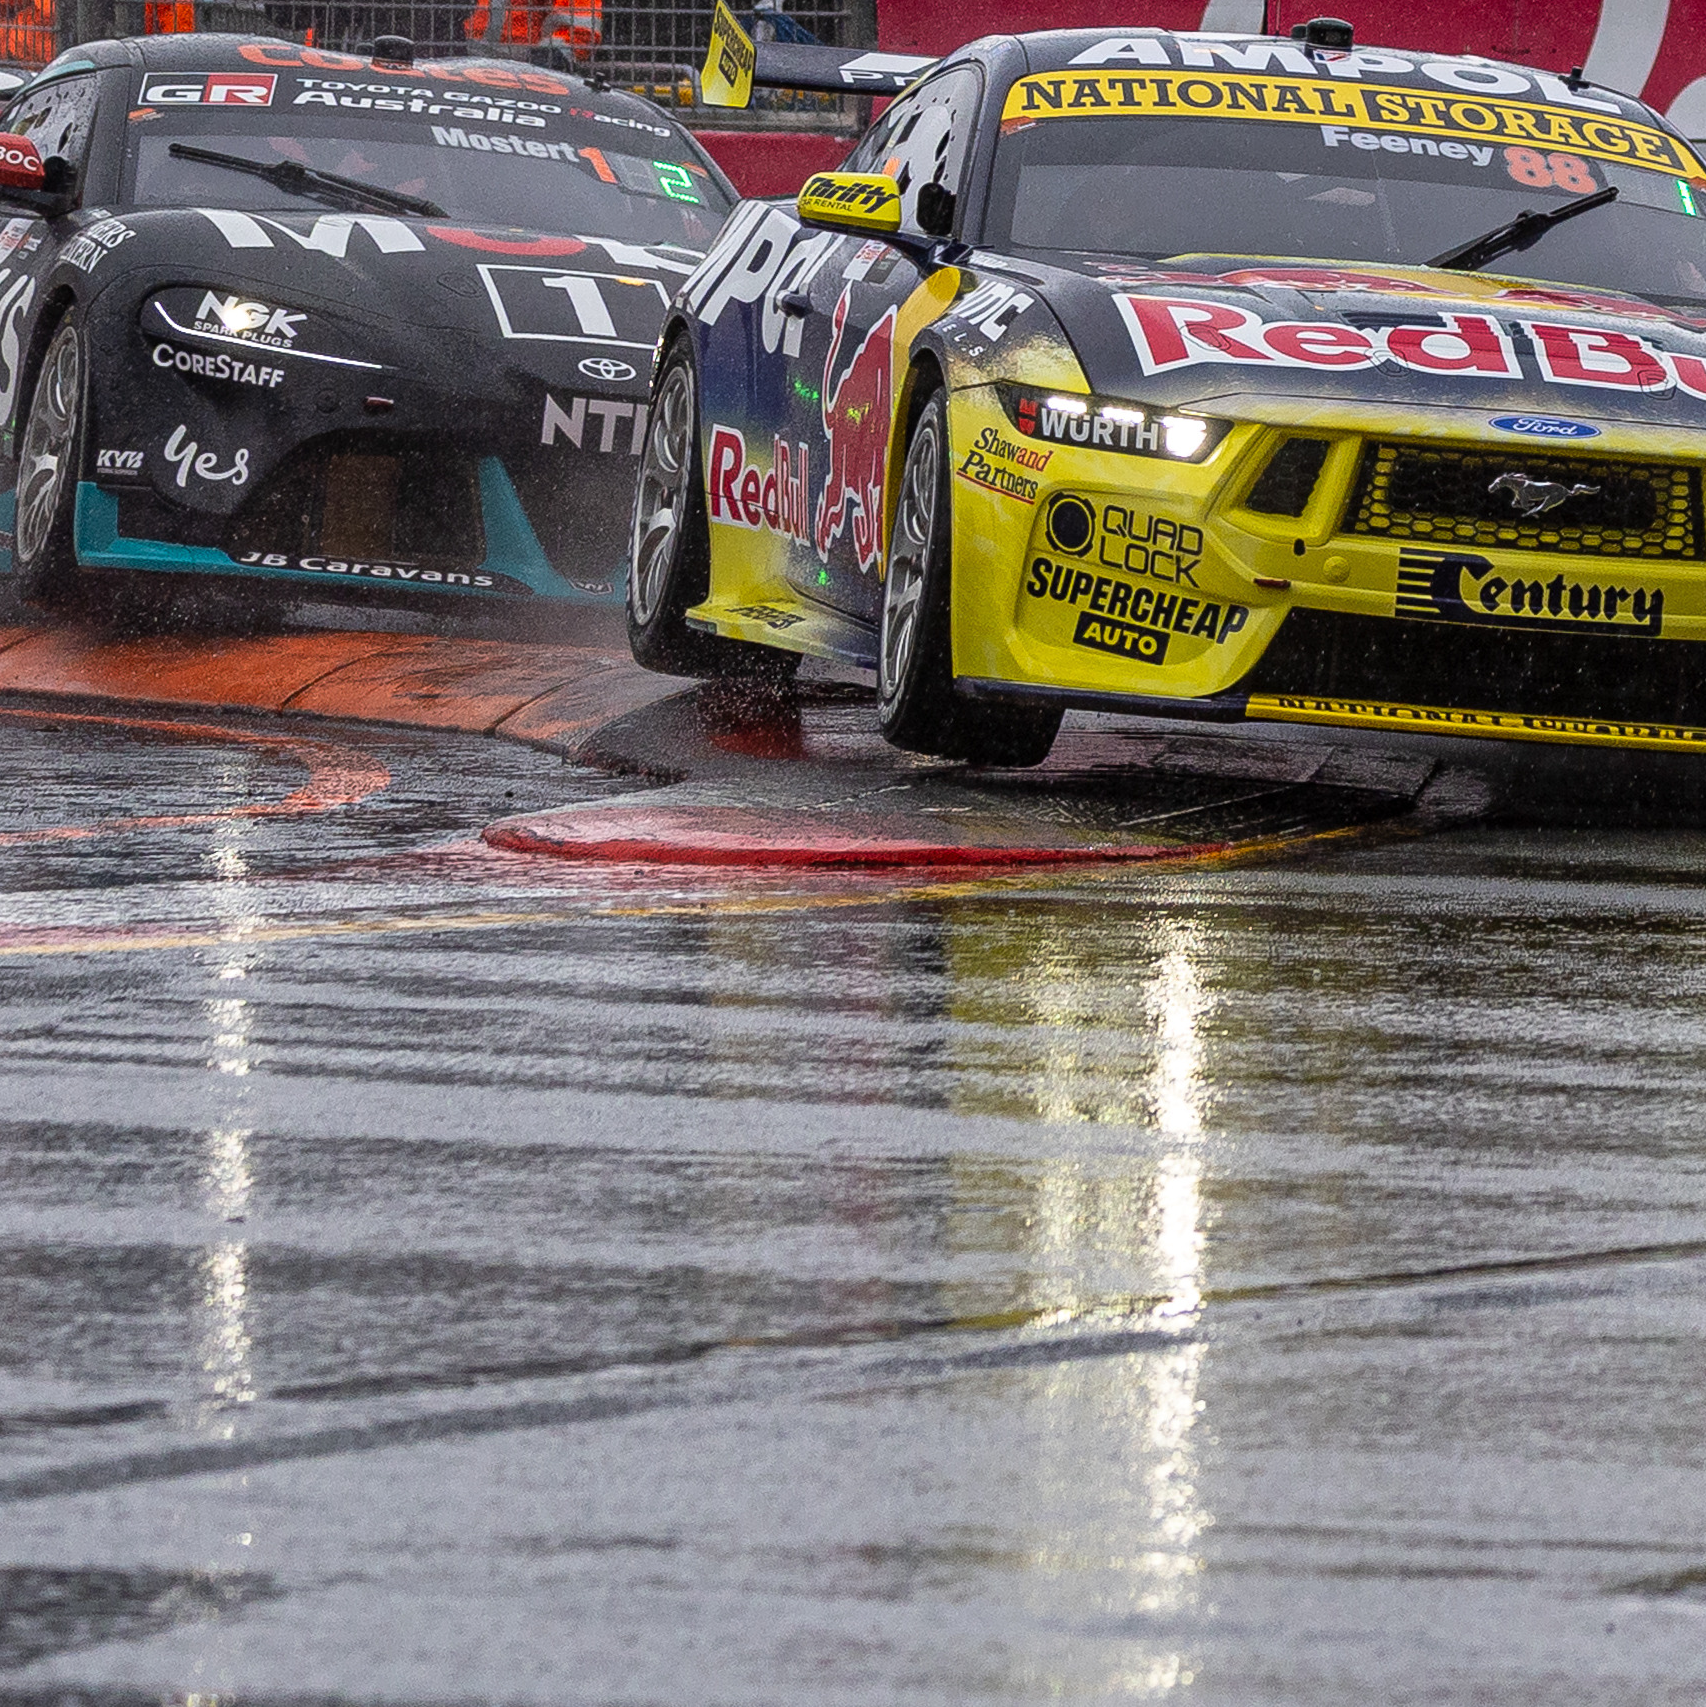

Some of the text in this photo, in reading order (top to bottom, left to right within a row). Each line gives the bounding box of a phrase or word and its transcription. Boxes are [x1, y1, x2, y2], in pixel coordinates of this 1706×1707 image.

[145, 84, 269, 104] GR
[296, 79, 434, 97] TOYOTA
[444, 91, 561, 114] GAZOO
[1067, 38, 1624, 115] AMPOL
[293, 91, 546, 127] Australia
[1020, 78, 1674, 166] NATIONAL STORAGE
[431, 126, 579, 162] Mostert
[1320, 125, 1494, 167] Feeney
[578, 147, 618, 184] 1
[653, 161, 699, 202] 2
[1503, 147, 1597, 194] 88
[803, 177, 899, 213] Thrifty
[813, 199, 853, 211] RENTAL
[196, 290, 307, 338] NGK
[543, 275, 617, 337] 1
[193, 321, 293, 348] SPARK PLUGS
[1112, 293, 1523, 380] Red
[1513, 418, 1577, 436] Ford
[96, 449, 144, 468] KYB
[959, 450, 1039, 499] Partners
[1103, 505, 1203, 556] QUAD
[239, 550, 494, 588] JB Caravans
[1100, 535, 1201, 588] LOCK
[1027, 557, 1249, 644] SUPERCHEAP
[1403, 548, 1664, 636] Century
[1082, 621, 1157, 655] AUTO
